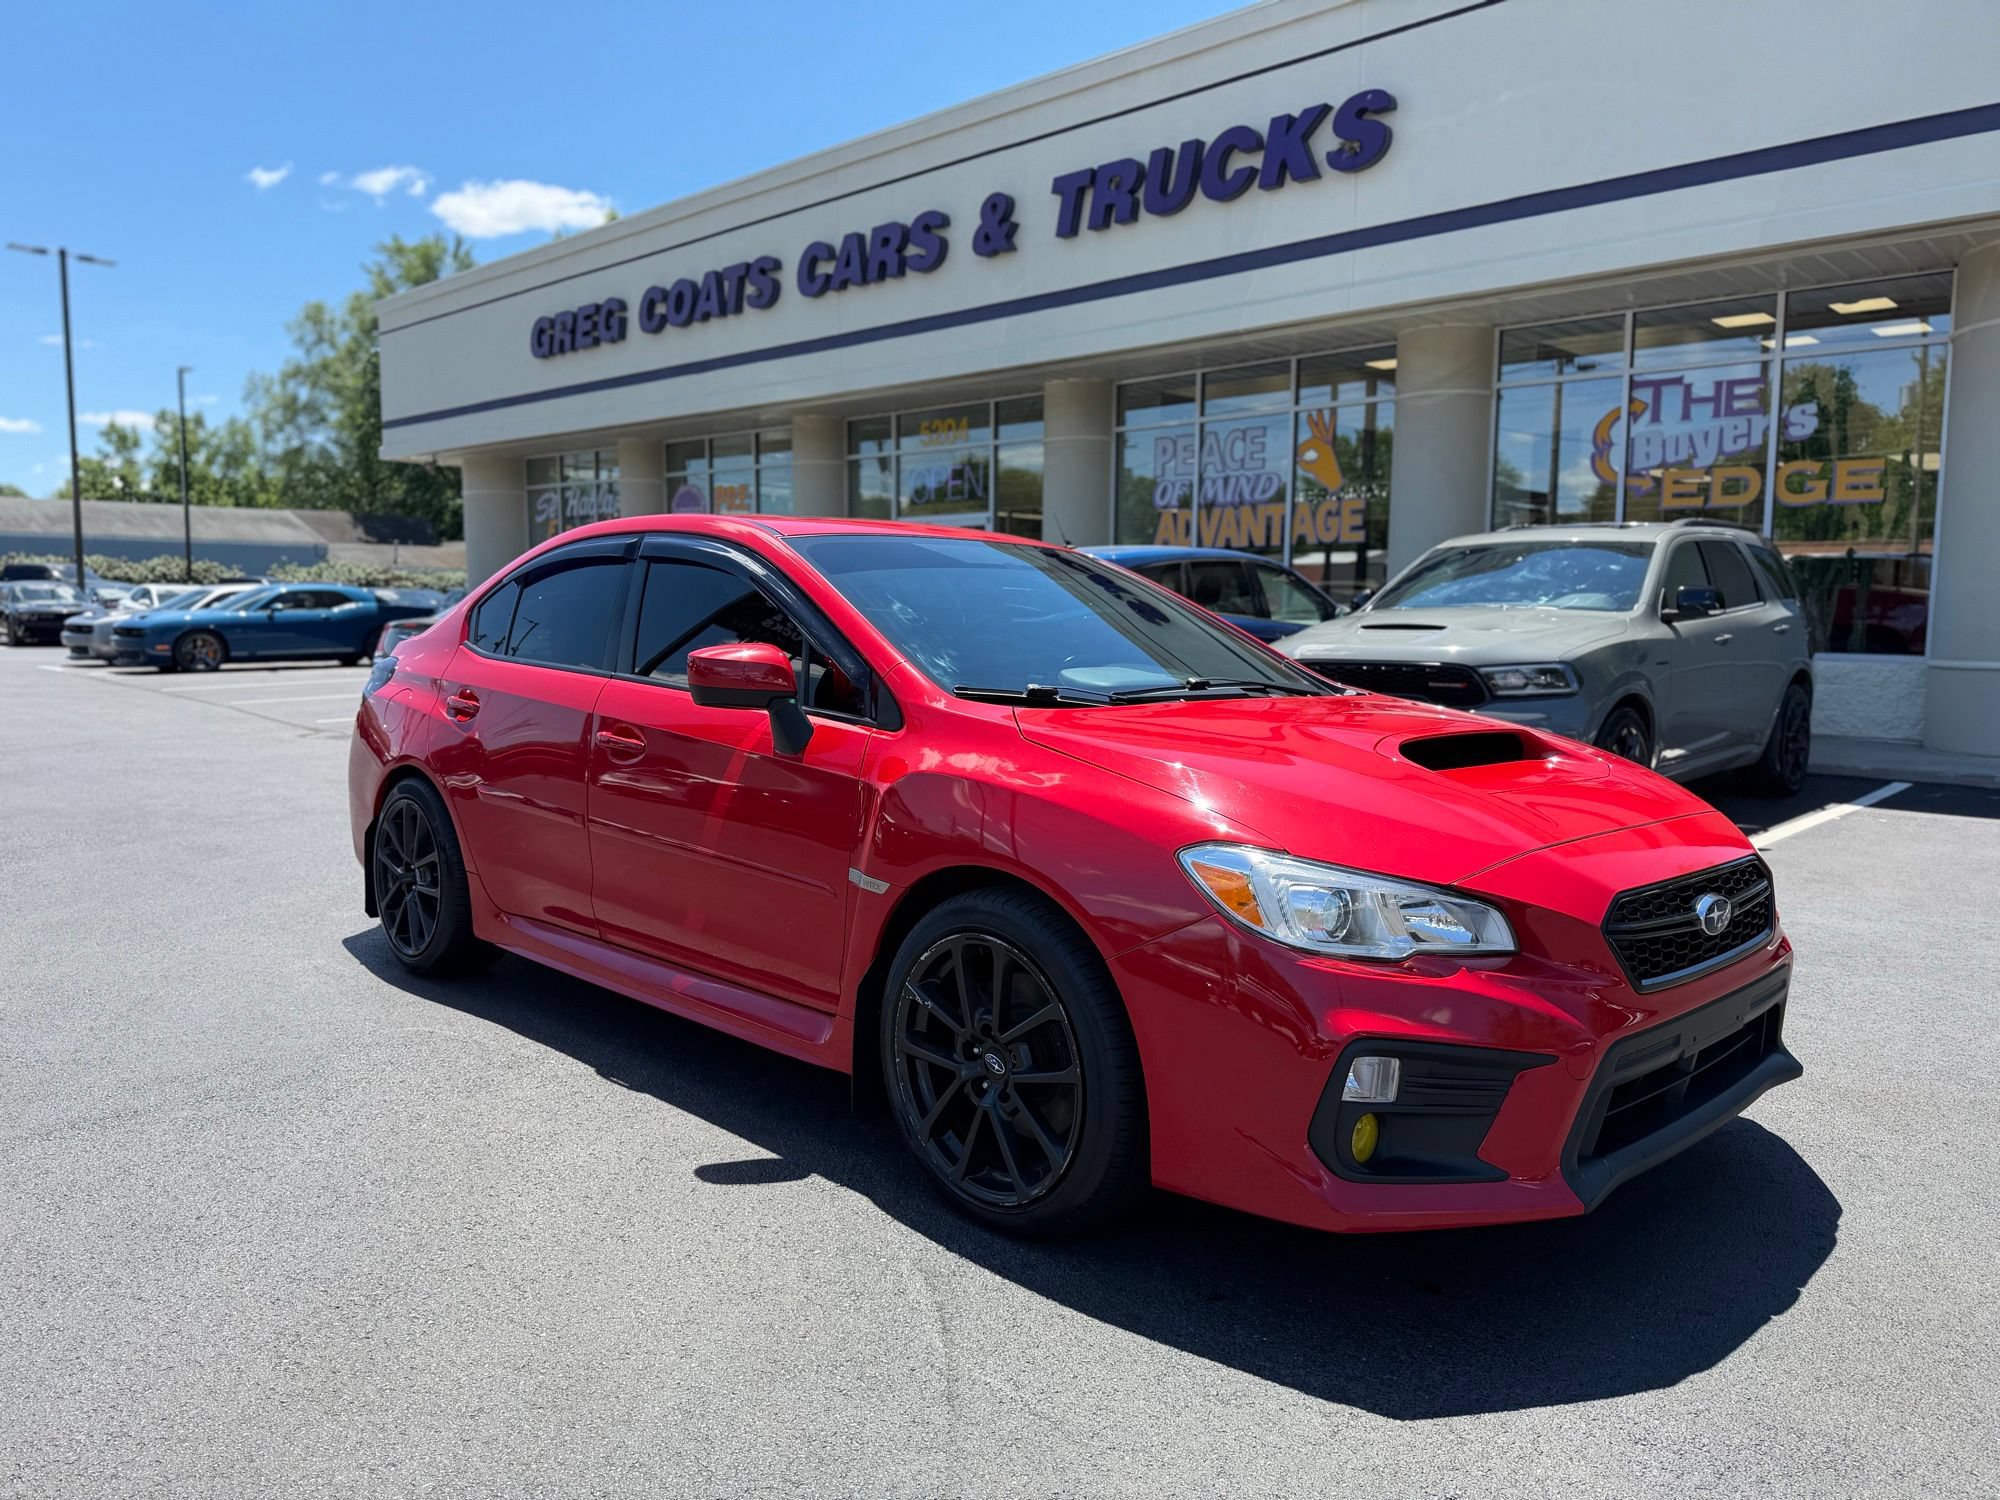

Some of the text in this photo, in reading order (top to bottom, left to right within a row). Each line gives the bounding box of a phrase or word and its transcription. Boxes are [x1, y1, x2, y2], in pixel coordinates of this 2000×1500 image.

[530, 88, 1398, 359] GREG COATS CARS & TRUCKS
[1631, 376, 1765, 423] THE
[1154, 426, 1267, 477] PEACE
[908, 463, 985, 505] OPEN
[1154, 479, 1193, 508] OF
[1200, 471, 1281, 505] MIND
[1660, 458, 1886, 511] EDGE
[1154, 498, 1366, 549] ADVANTAGE
[862, 878, 882, 891] WRX
